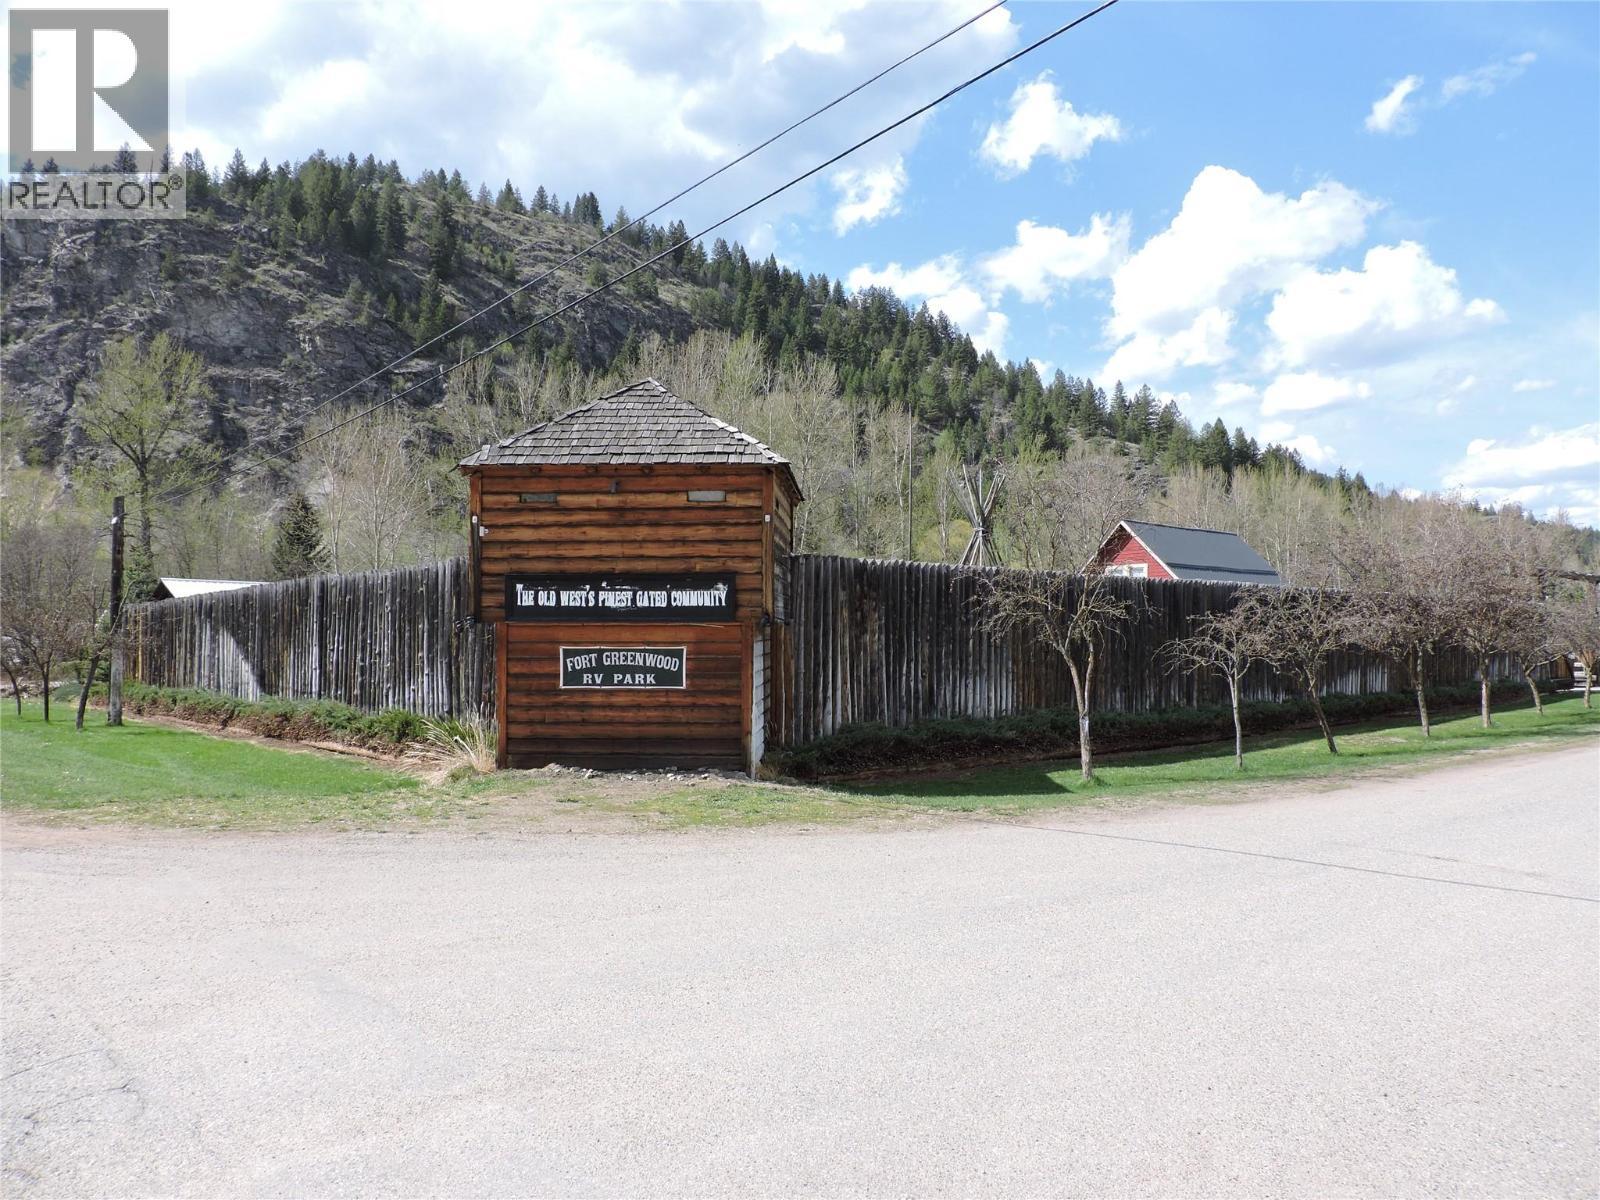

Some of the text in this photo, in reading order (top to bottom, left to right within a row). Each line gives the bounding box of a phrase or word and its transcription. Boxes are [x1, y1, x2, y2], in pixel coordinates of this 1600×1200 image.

[538, 590, 556, 607] OLD
[560, 585, 595, 607] WEST'S
[636, 590, 667, 607] GATED
[671, 588, 727, 607] COMMUNITY
[566, 651, 680, 672] FORT GREENWOOD
[583, 673, 656, 685] RV PARK
